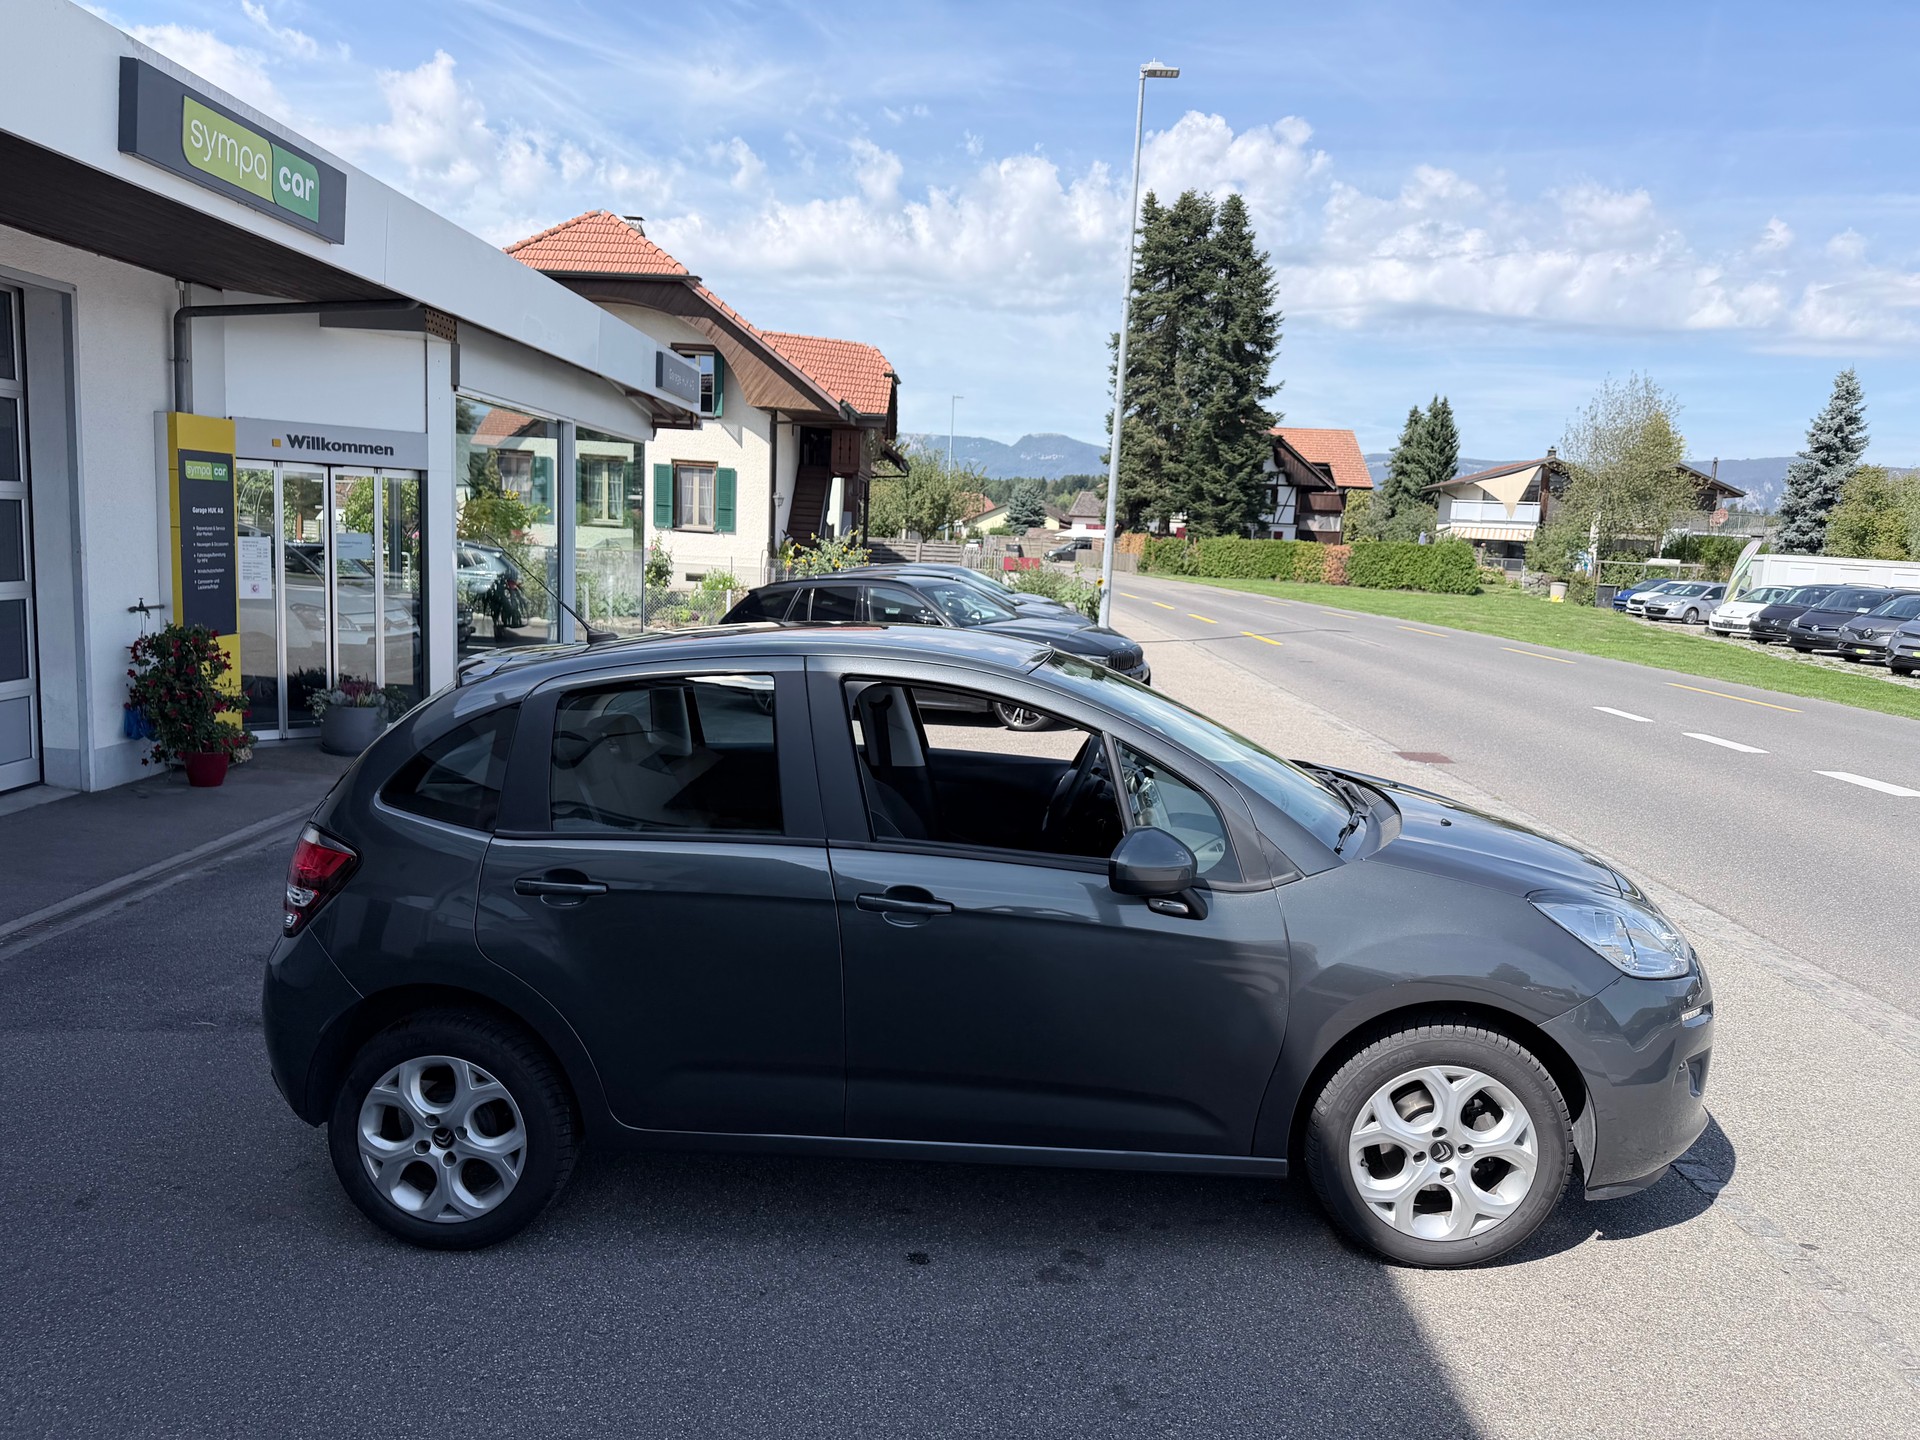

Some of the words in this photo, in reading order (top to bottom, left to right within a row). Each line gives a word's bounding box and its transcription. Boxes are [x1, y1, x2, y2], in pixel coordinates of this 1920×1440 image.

[190, 119, 267, 180] sympa
[278, 166, 314, 202] car
[286, 433, 395, 457] Willkommen
[186, 465, 211, 477] sympa
[213, 467, 227, 476] car
[192, 506, 207, 514] Garage
